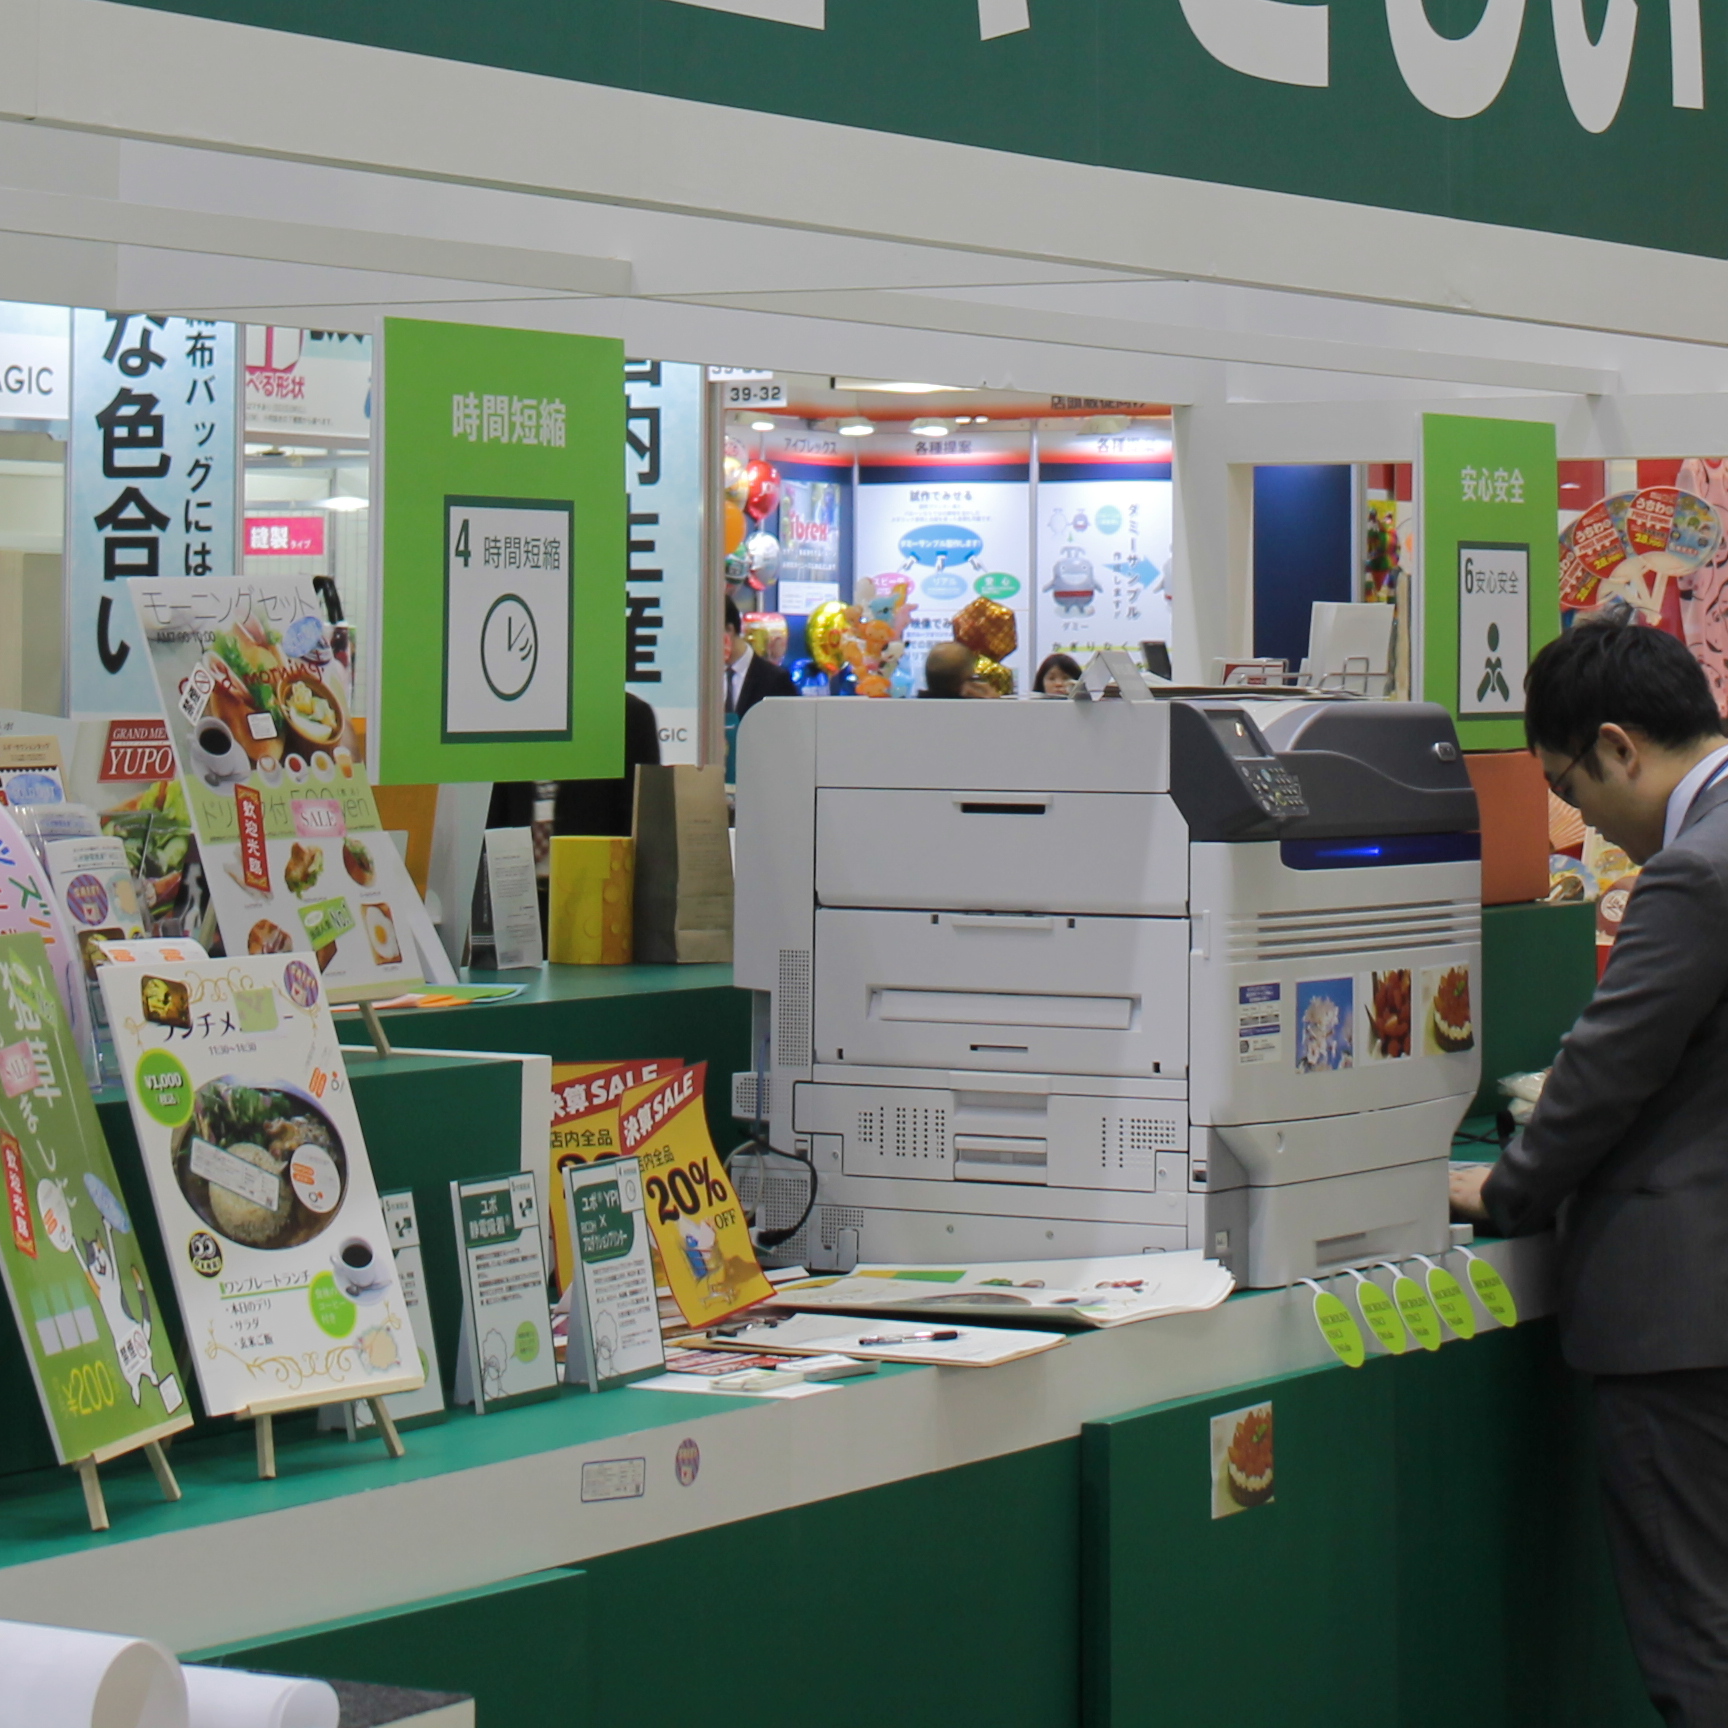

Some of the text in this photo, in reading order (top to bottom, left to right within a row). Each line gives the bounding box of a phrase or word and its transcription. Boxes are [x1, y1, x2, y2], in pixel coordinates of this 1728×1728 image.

[730, 386, 782, 403] 39-32
[452, 392, 566, 449] 時間短縮
[184, 318, 217, 576] 布バッグには
[784, 437, 838, 456] アイブレックス
[915, 440, 973, 456] 各種提案
[910, 490, 973, 503] 試作でみせる
[1460, 466, 1525, 507] 安心安全
[250, 526, 289, 550] 縫製
[455, 518, 561, 572] 4 時間短縮
[1126, 503, 1141, 620] ダミーサンプル
[1464, 557, 1519, 596] 6 安心安全
[142, 586, 315, 625] モーニングセット
[113, 725, 147, 741] GRAND
[109, 746, 173, 776] YUPO
[300, 808, 338, 828] SALE
[143, 1071, 183, 1092] ¥1,000
[622, 1069, 695, 1148] 決算 SALE
[549, 1128, 613, 1150] 店内全品
[645, 1156, 728, 1226] 20%
[713, 1207, 737, 1230] OFF
[224, 1270, 311, 1294] ワンプレートランチ
